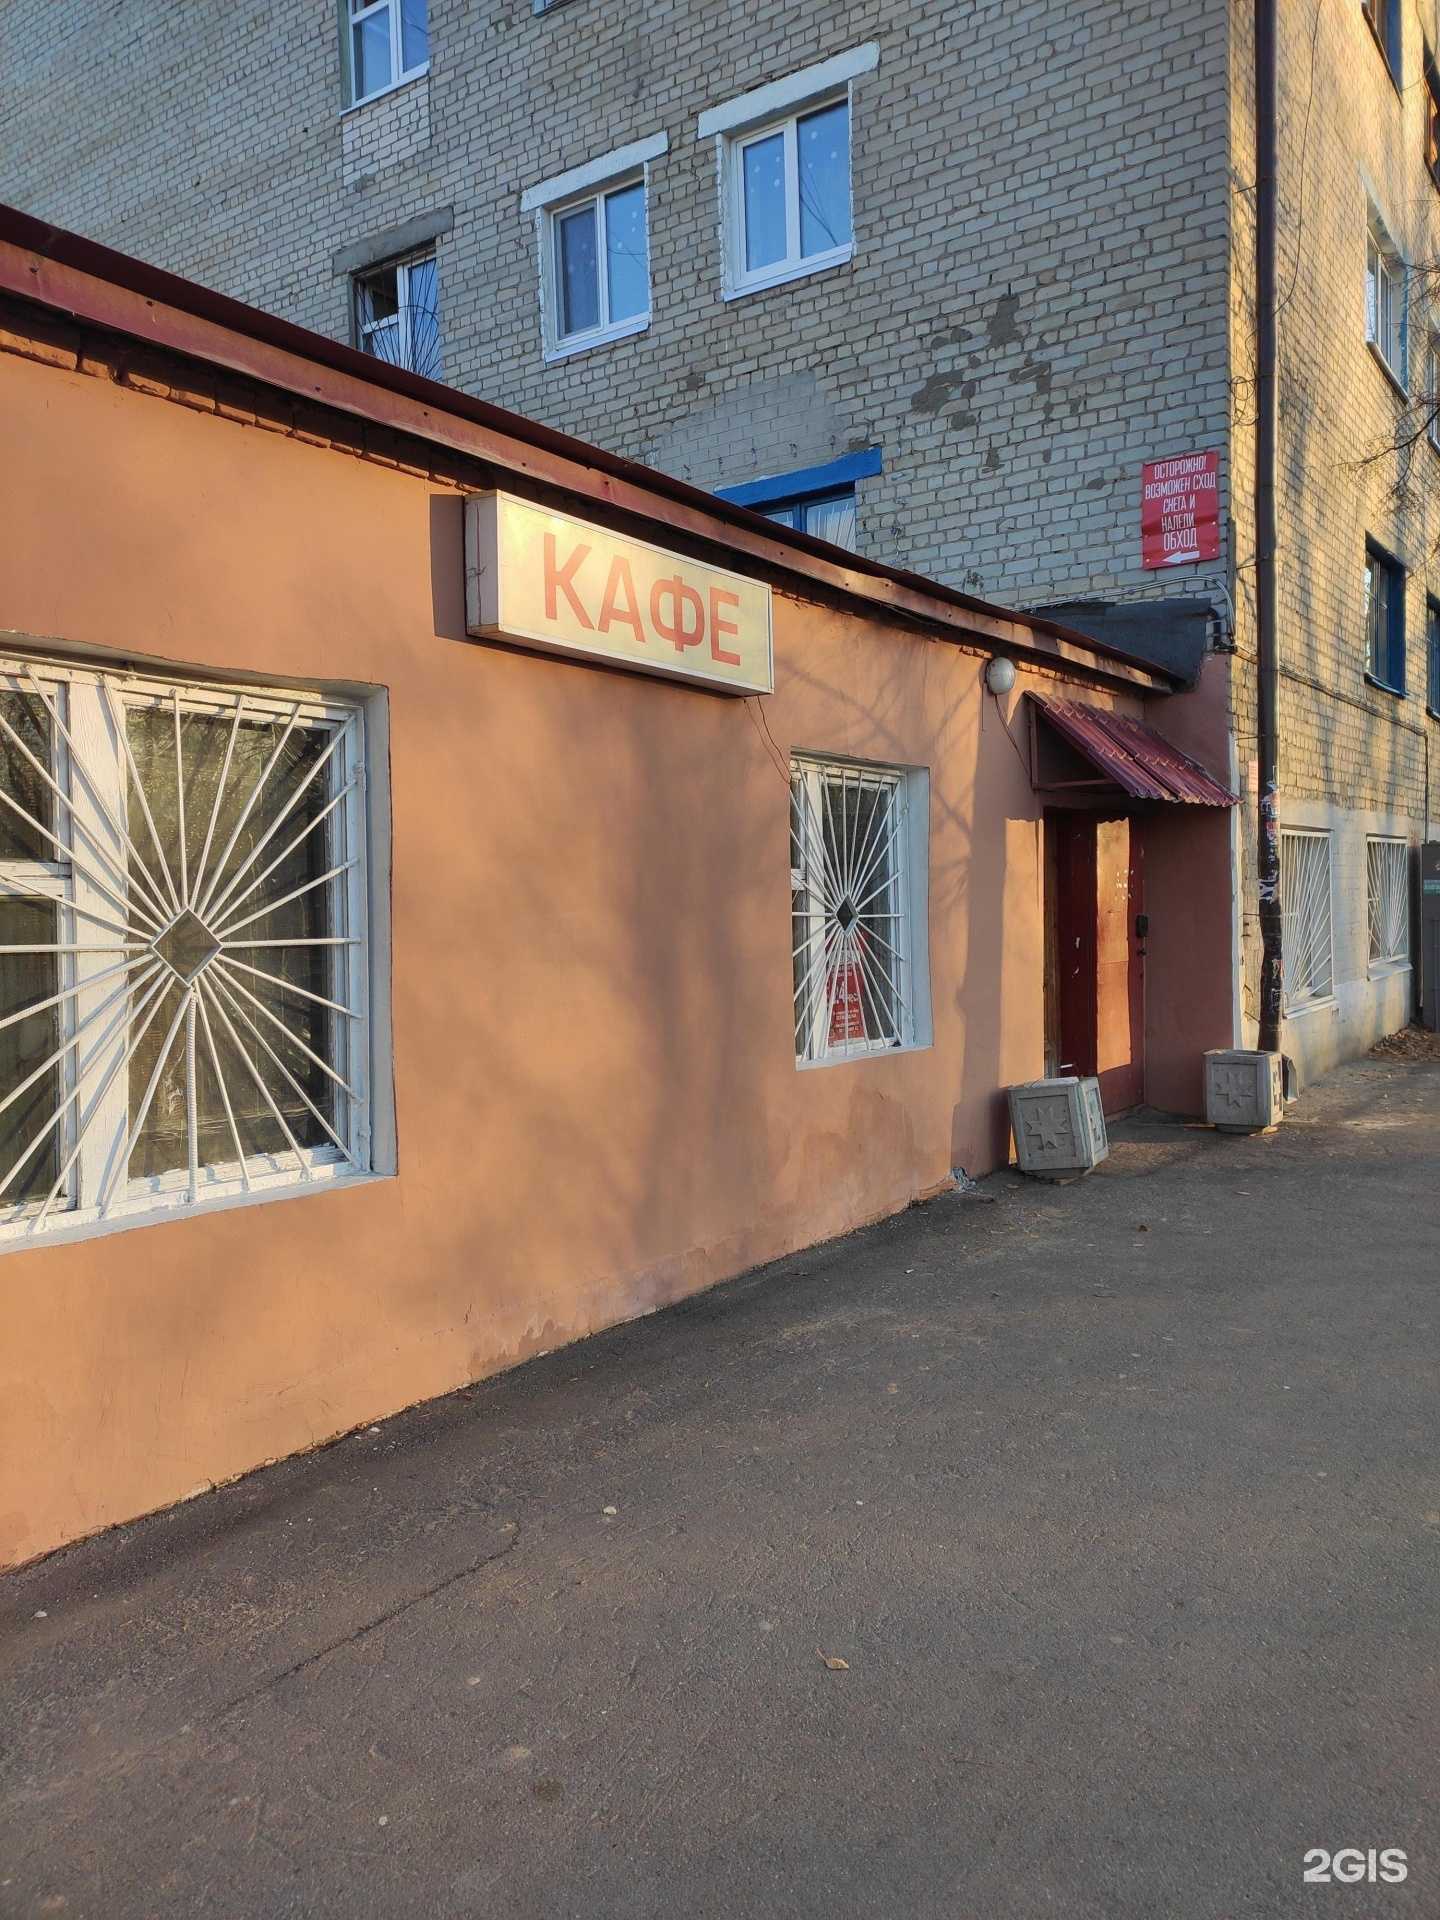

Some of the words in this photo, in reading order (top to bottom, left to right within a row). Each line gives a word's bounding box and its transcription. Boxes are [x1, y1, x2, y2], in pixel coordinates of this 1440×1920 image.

[1154, 456, 1207, 479] ОСТОРОЖНО!
[1145, 477, 1190, 499] ВОЗМОЖЕН
[1193, 472, 1216, 490] СХОД
[1163, 496, 1186, 513] СНЕГА
[1190, 495, 1195, 509] И
[1164, 528, 1197, 551] ОБХОД
[543, 532, 741, 666] КАФЕ
